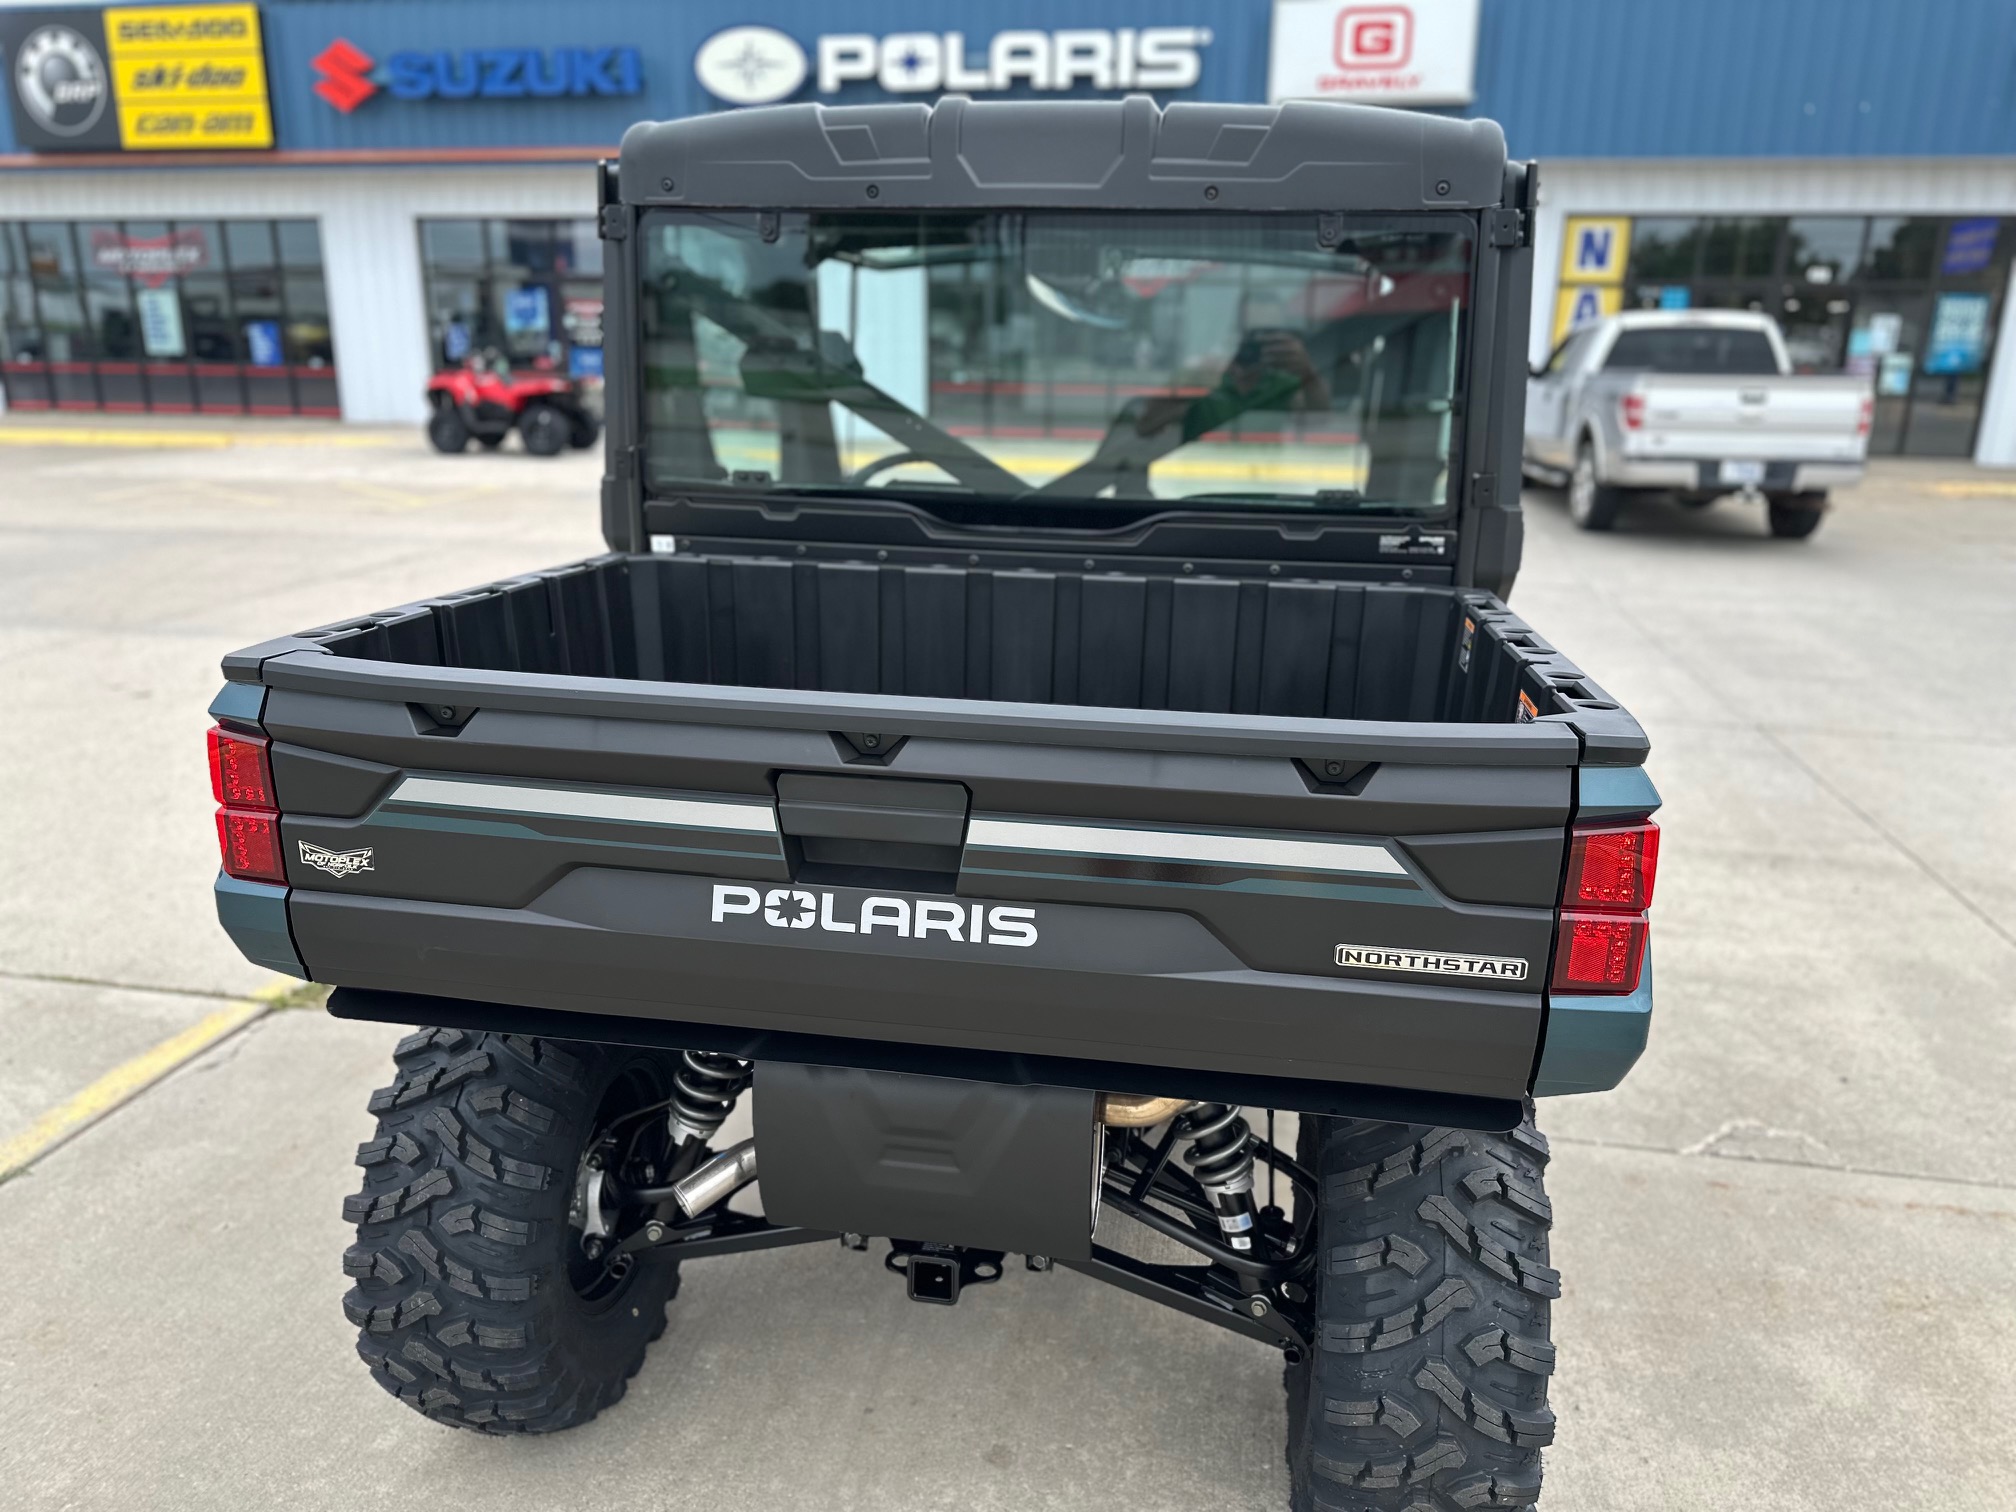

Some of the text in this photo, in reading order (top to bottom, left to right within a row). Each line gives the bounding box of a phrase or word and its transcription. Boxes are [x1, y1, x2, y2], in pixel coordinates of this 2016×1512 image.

[387, 46, 643, 98] SUZUKI
[817, 27, 1202, 93] POLARIS
[304, 853, 370, 867] MOTOPLEX
[711, 884, 1039, 948] POLARIS
[1344, 950, 1520, 976] NORTHSTAR
